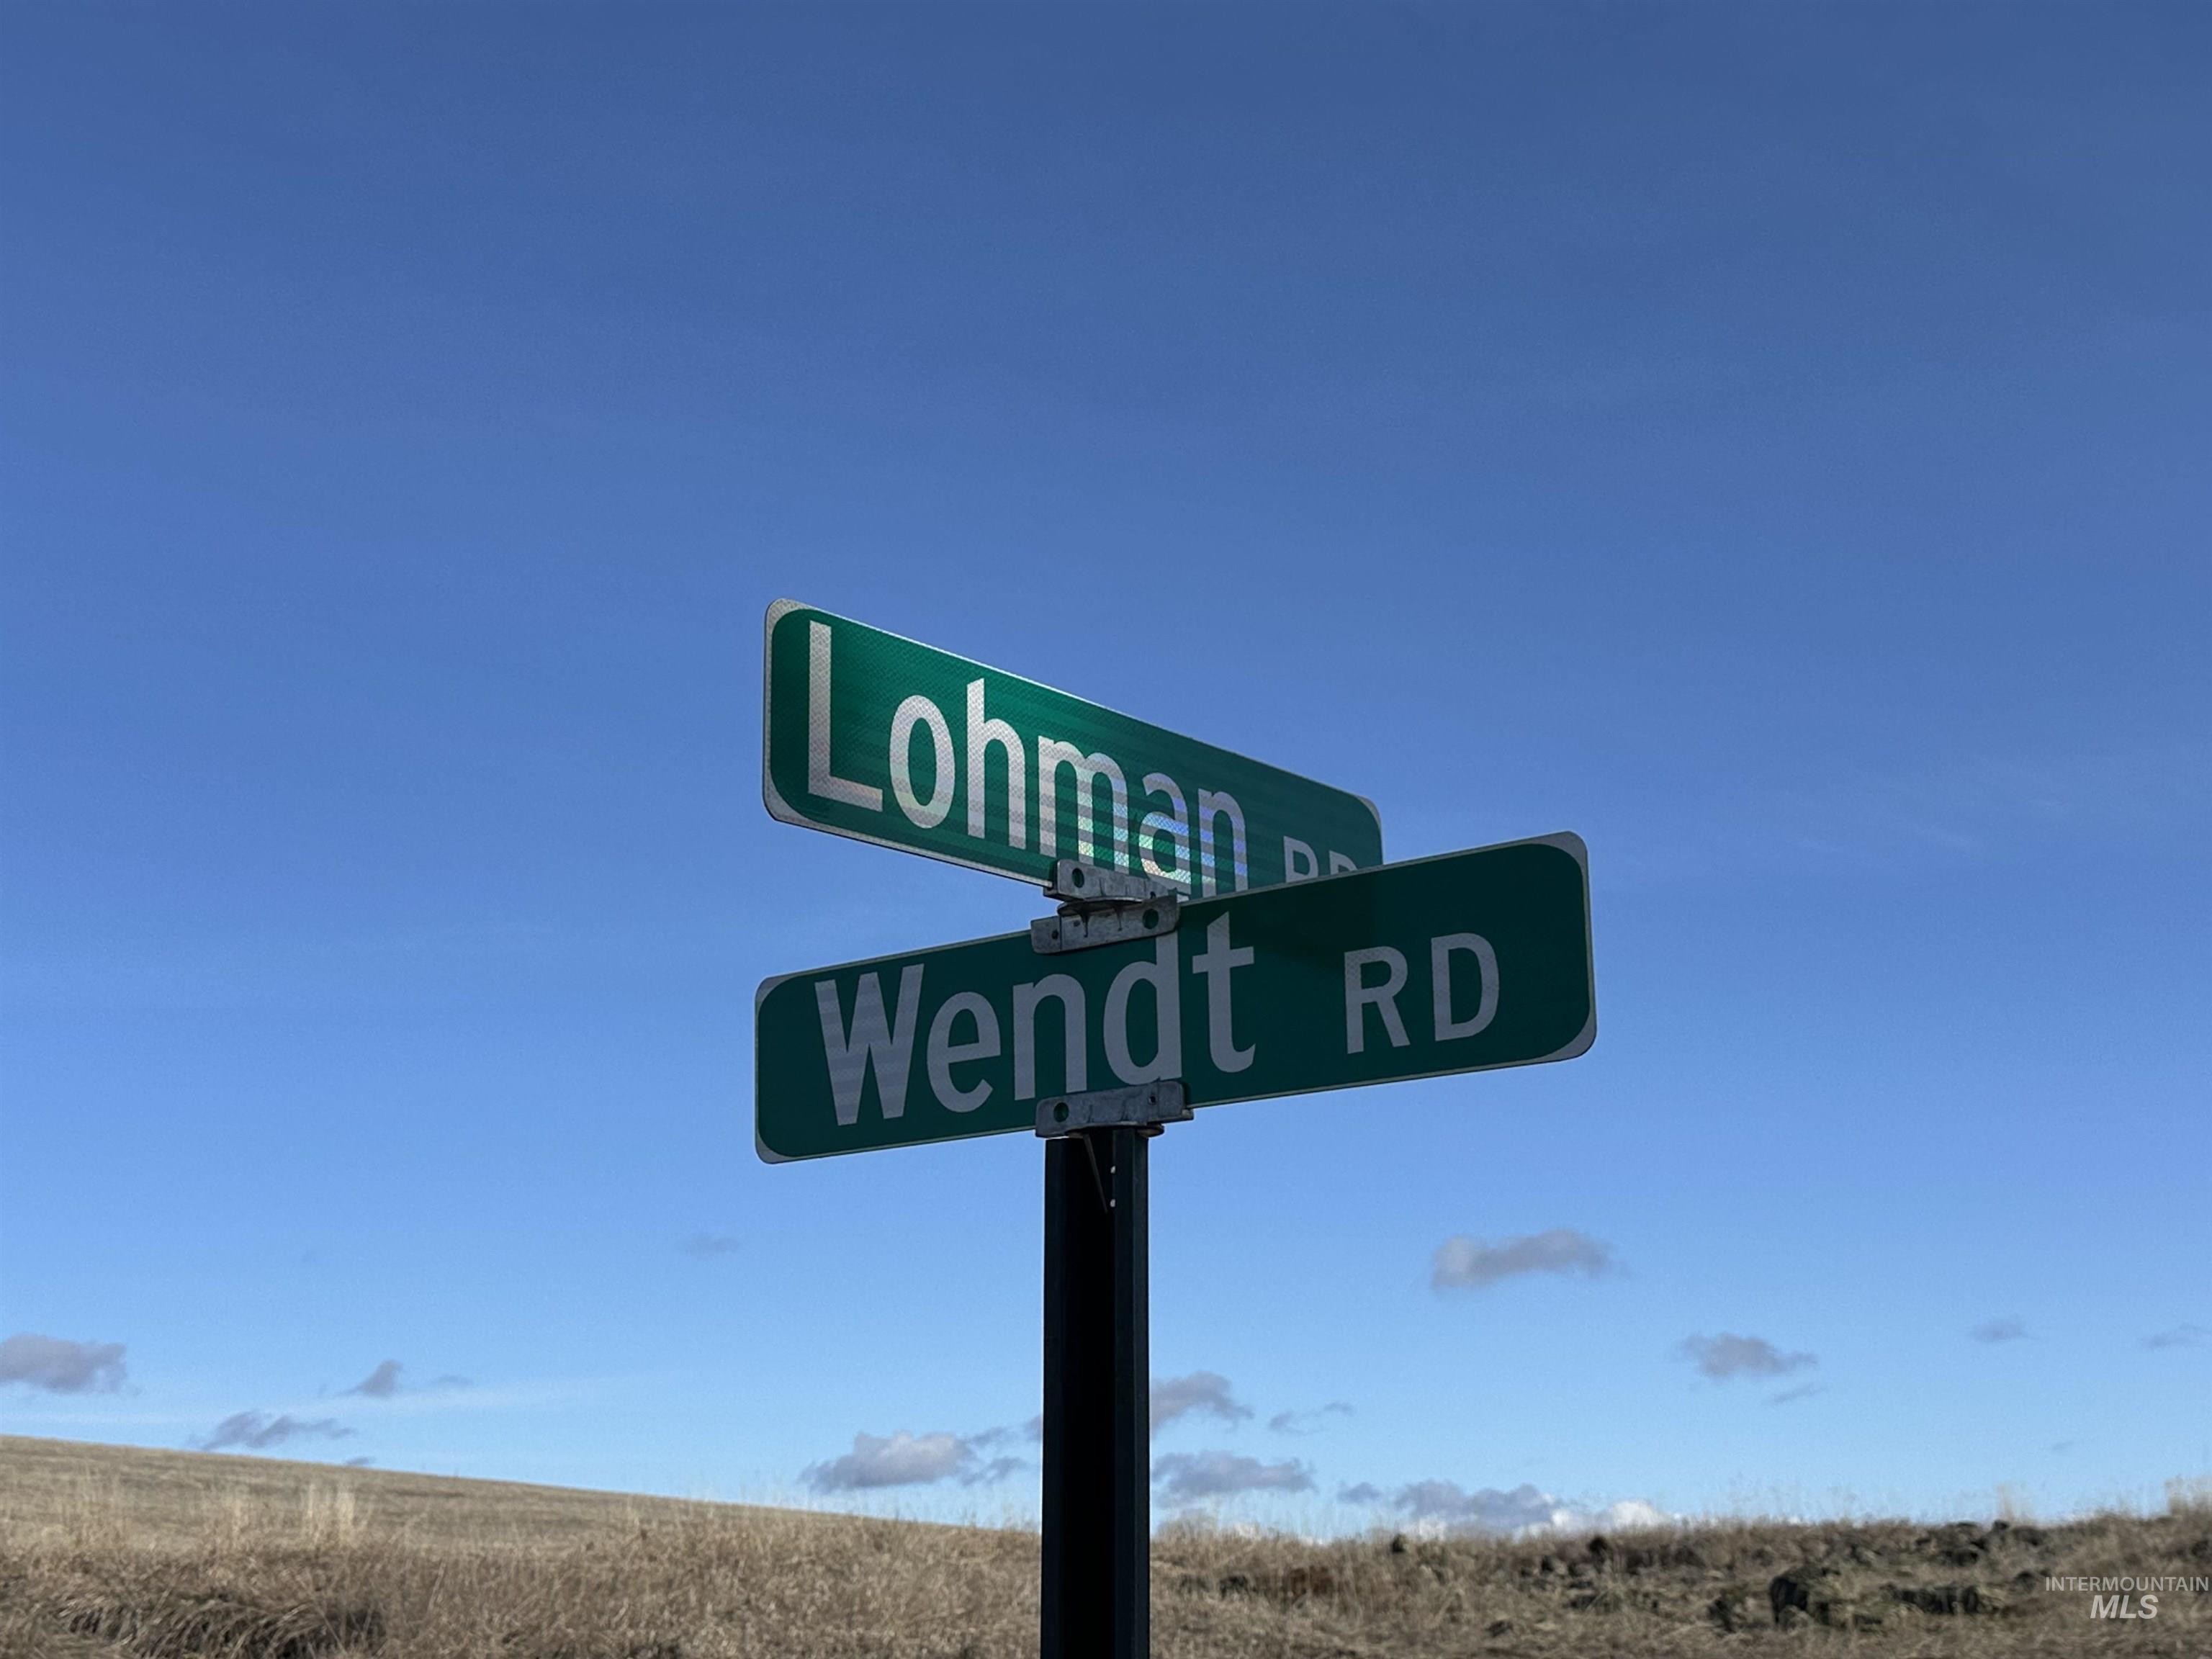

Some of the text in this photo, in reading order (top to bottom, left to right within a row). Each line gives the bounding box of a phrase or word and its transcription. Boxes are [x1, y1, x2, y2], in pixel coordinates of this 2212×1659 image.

[808, 620, 1359, 898] Lohman R
[814, 911, 1500, 1126] Wendt RD
